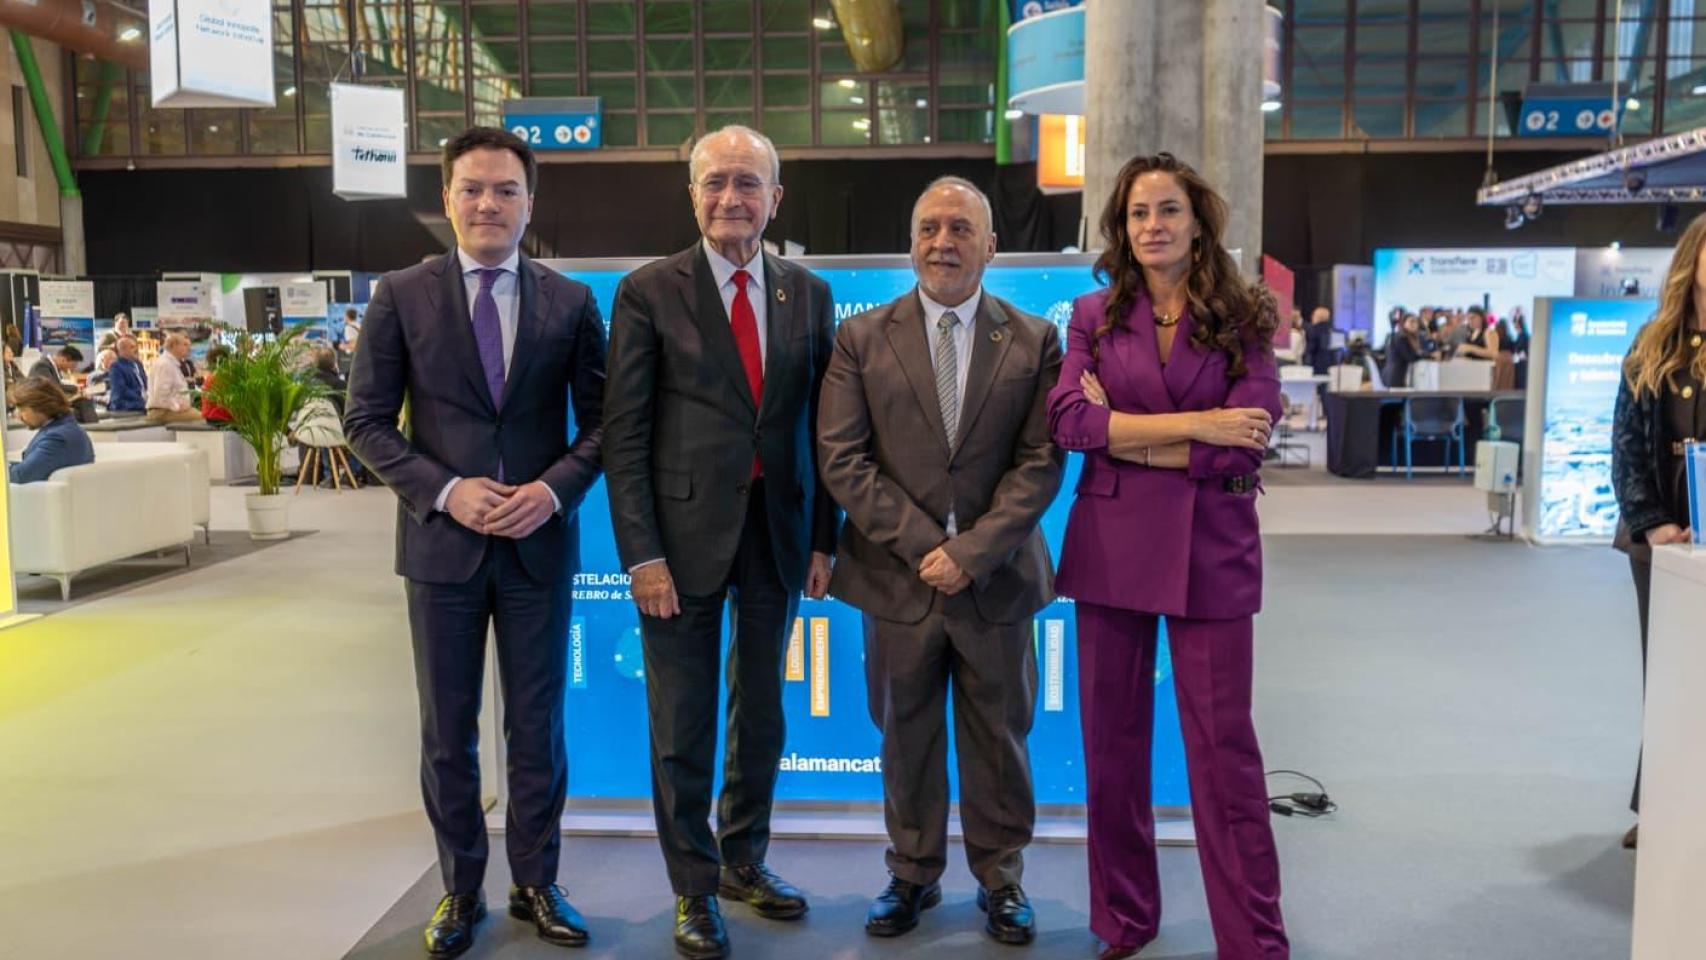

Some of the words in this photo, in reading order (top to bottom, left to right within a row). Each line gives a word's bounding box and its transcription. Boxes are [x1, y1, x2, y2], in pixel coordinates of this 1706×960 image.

[1546, 111, 1559, 131] 2
[530, 125, 541, 144] 2
[571, 590, 609, 600] REBRO
[611, 590, 622, 600] de
[624, 590, 633, 600] S
[570, 623, 582, 683] TECNOLOGÍA
[779, 752, 882, 773] alamancat
